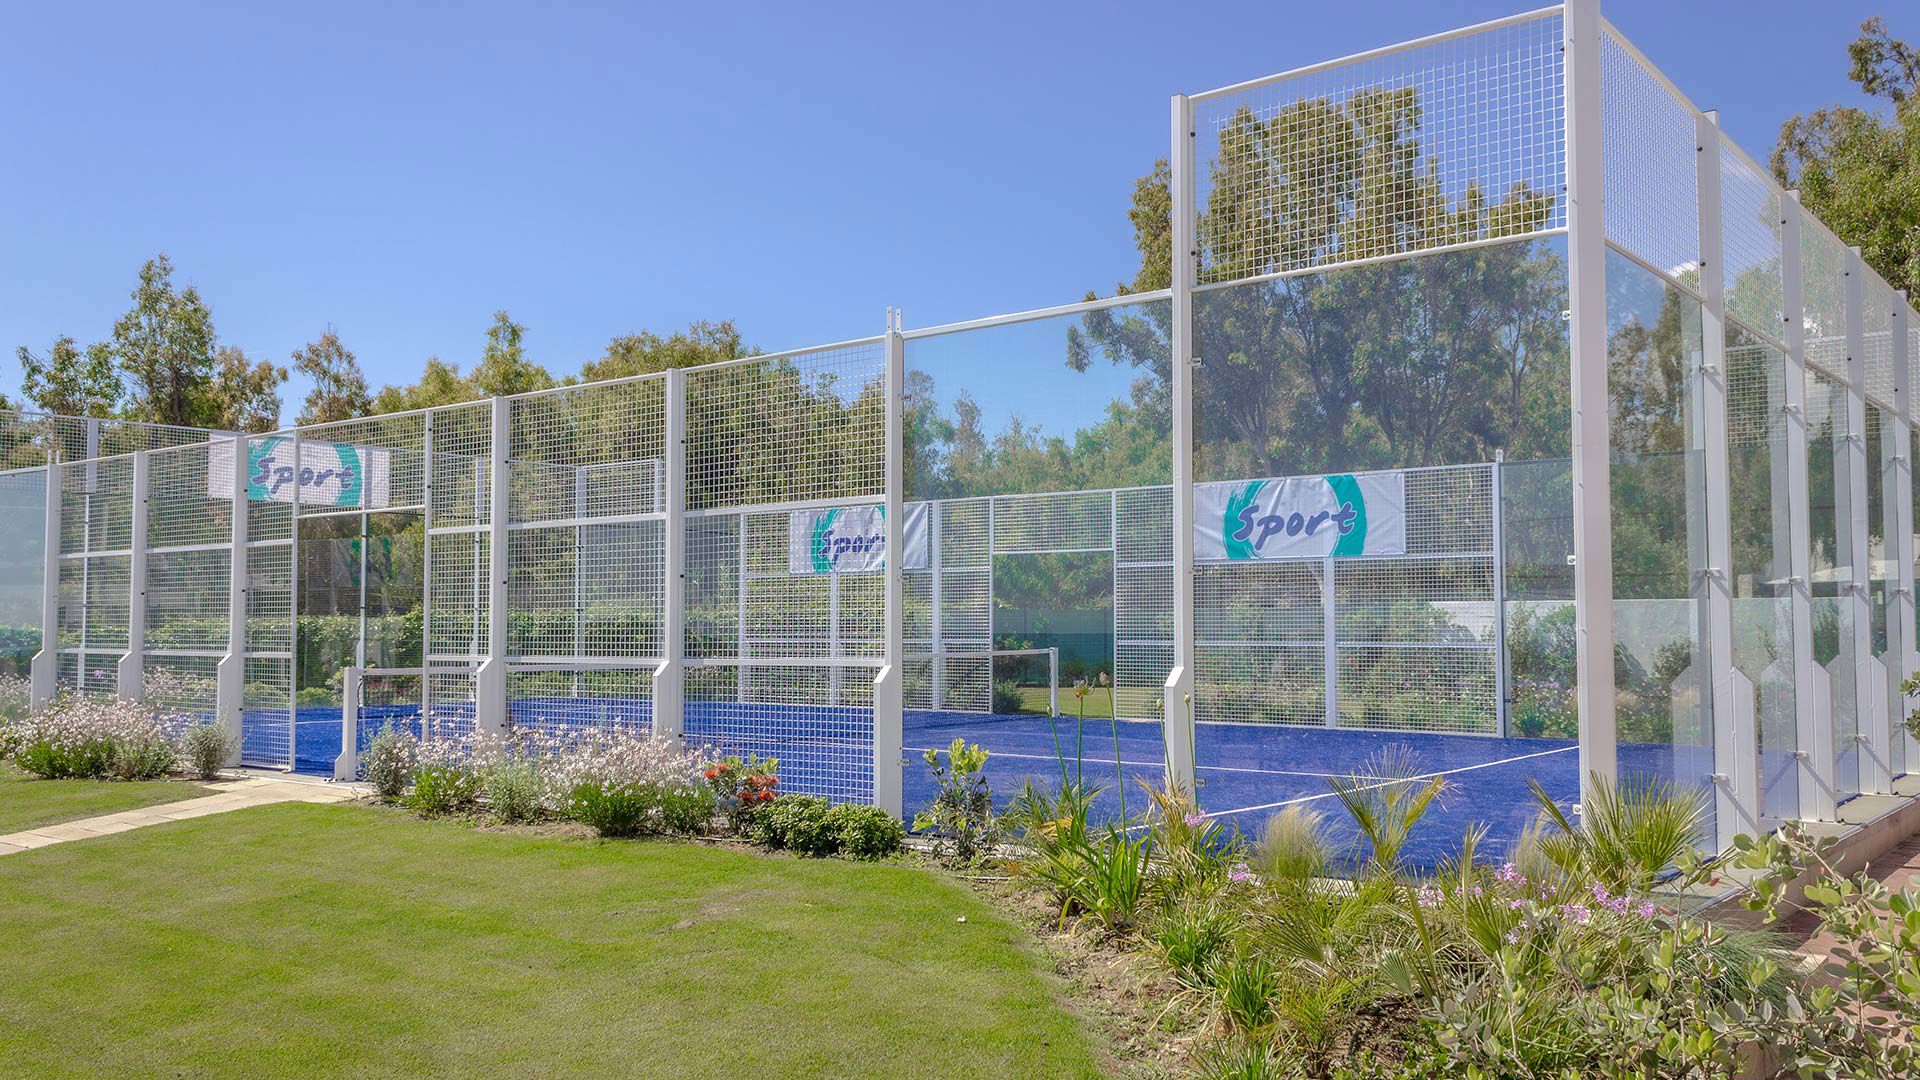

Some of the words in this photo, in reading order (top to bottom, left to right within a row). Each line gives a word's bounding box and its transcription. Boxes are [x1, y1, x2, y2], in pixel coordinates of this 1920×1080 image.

[251, 456, 354, 495] Sport
[1233, 502, 1356, 551] Sport
[818, 529, 886, 566] Spor
